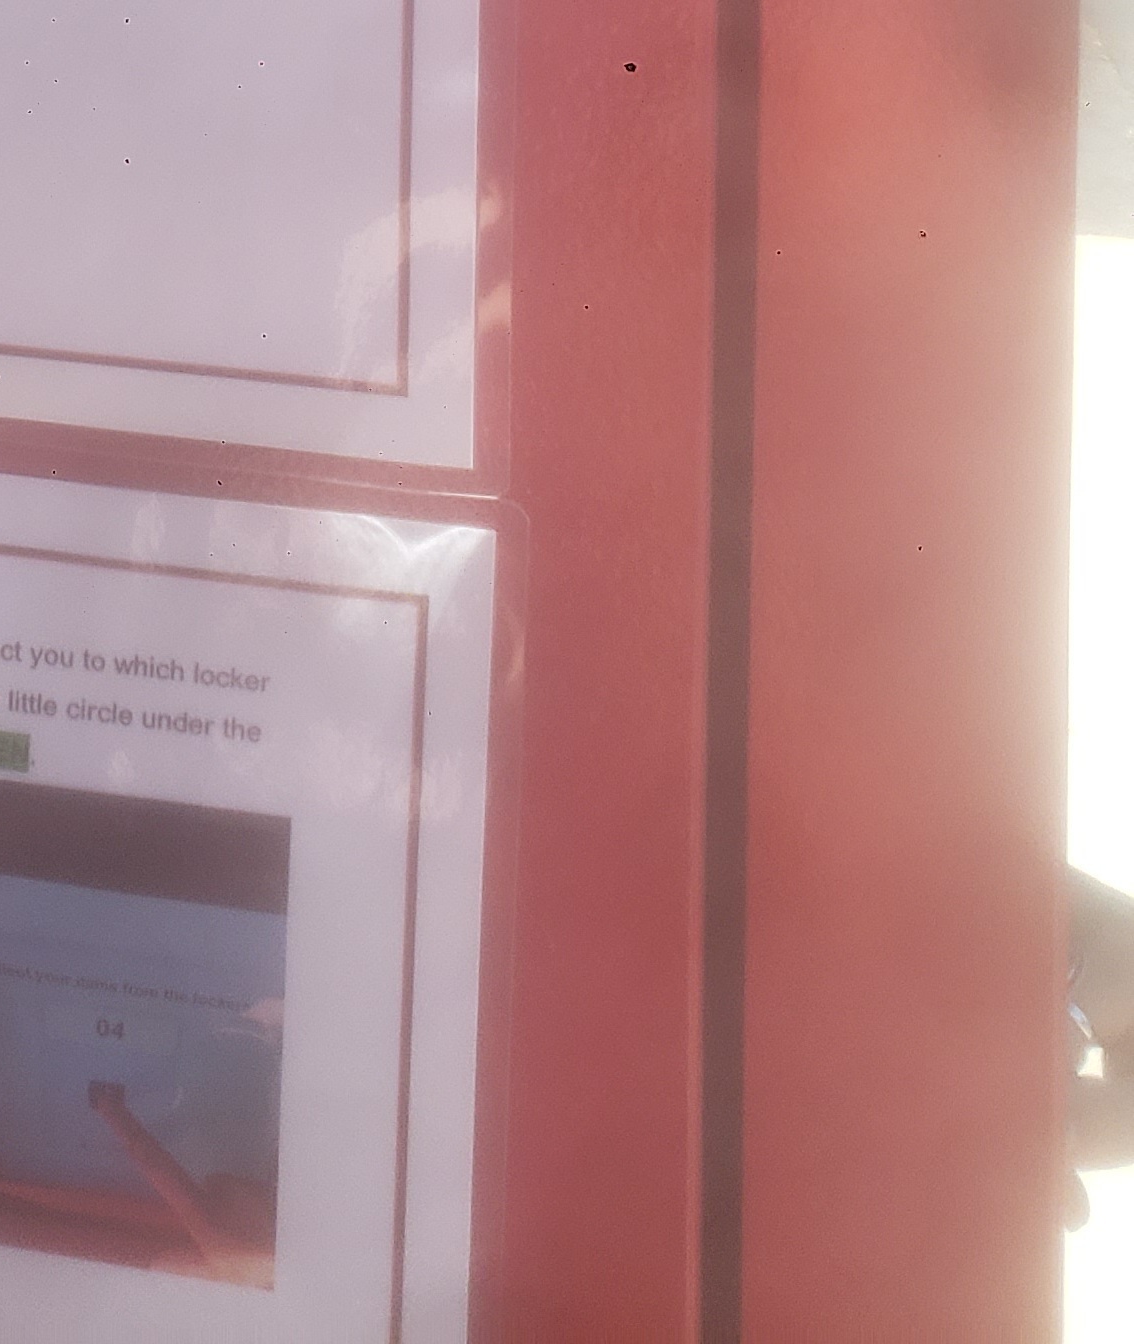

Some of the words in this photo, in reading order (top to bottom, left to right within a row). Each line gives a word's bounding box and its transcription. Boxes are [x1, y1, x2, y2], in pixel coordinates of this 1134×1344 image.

[29, 647, 75, 670] you
[82, 649, 107, 673] to
[113, 655, 185, 681] which
[192, 661, 270, 693] locker
[7, 690, 58, 718] little
[65, 699, 134, 727] circle
[140, 711, 214, 736] under
[221, 717, 262, 743] the
[95, 1018, 125, 1040] 04
